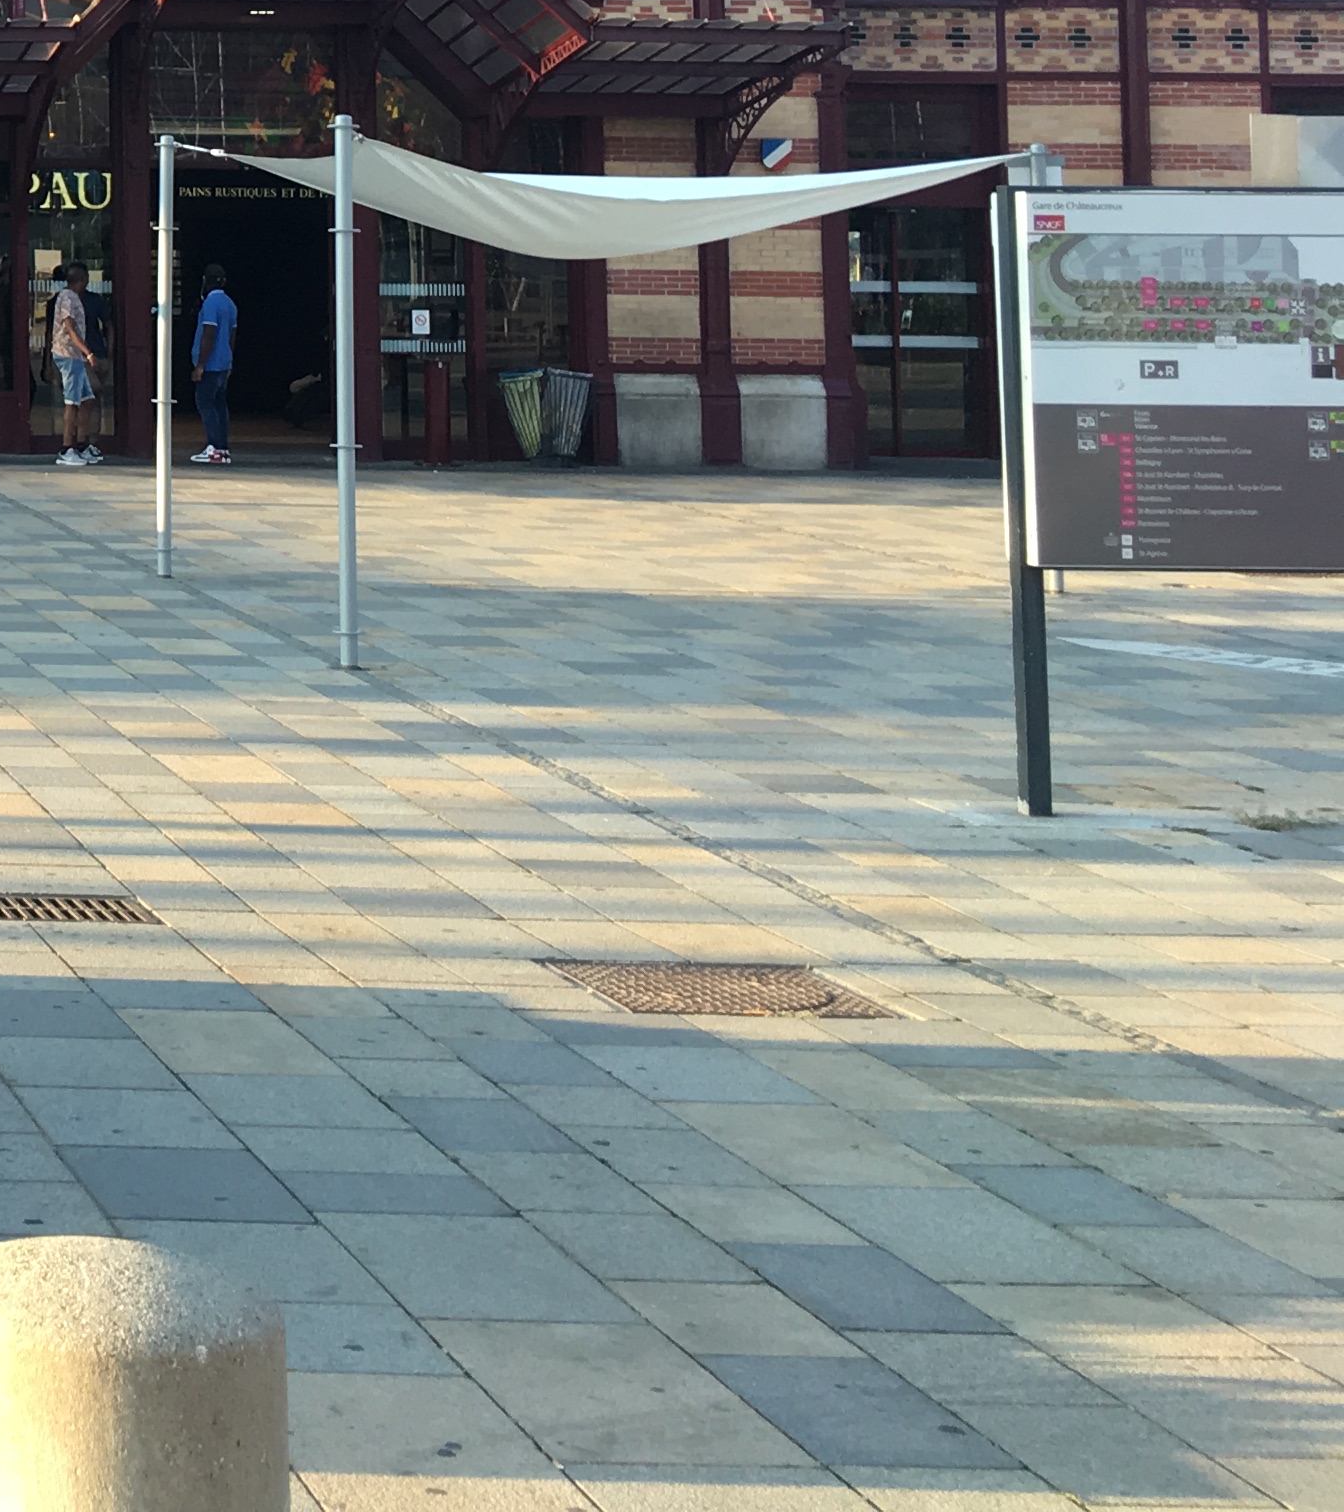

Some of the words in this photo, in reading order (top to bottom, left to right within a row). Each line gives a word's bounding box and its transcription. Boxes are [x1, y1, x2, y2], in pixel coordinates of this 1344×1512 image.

[179, 186, 211, 198] PAINS
[215, 186, 277, 199] RUSTIQUES
[281, 187, 295, 198] ET
[299, 187, 315, 198] DE
[1032, 200, 1052, 210] Gare
[1053, 200, 1064, 210] de
[1036, 220, 1063, 229] SNCF
